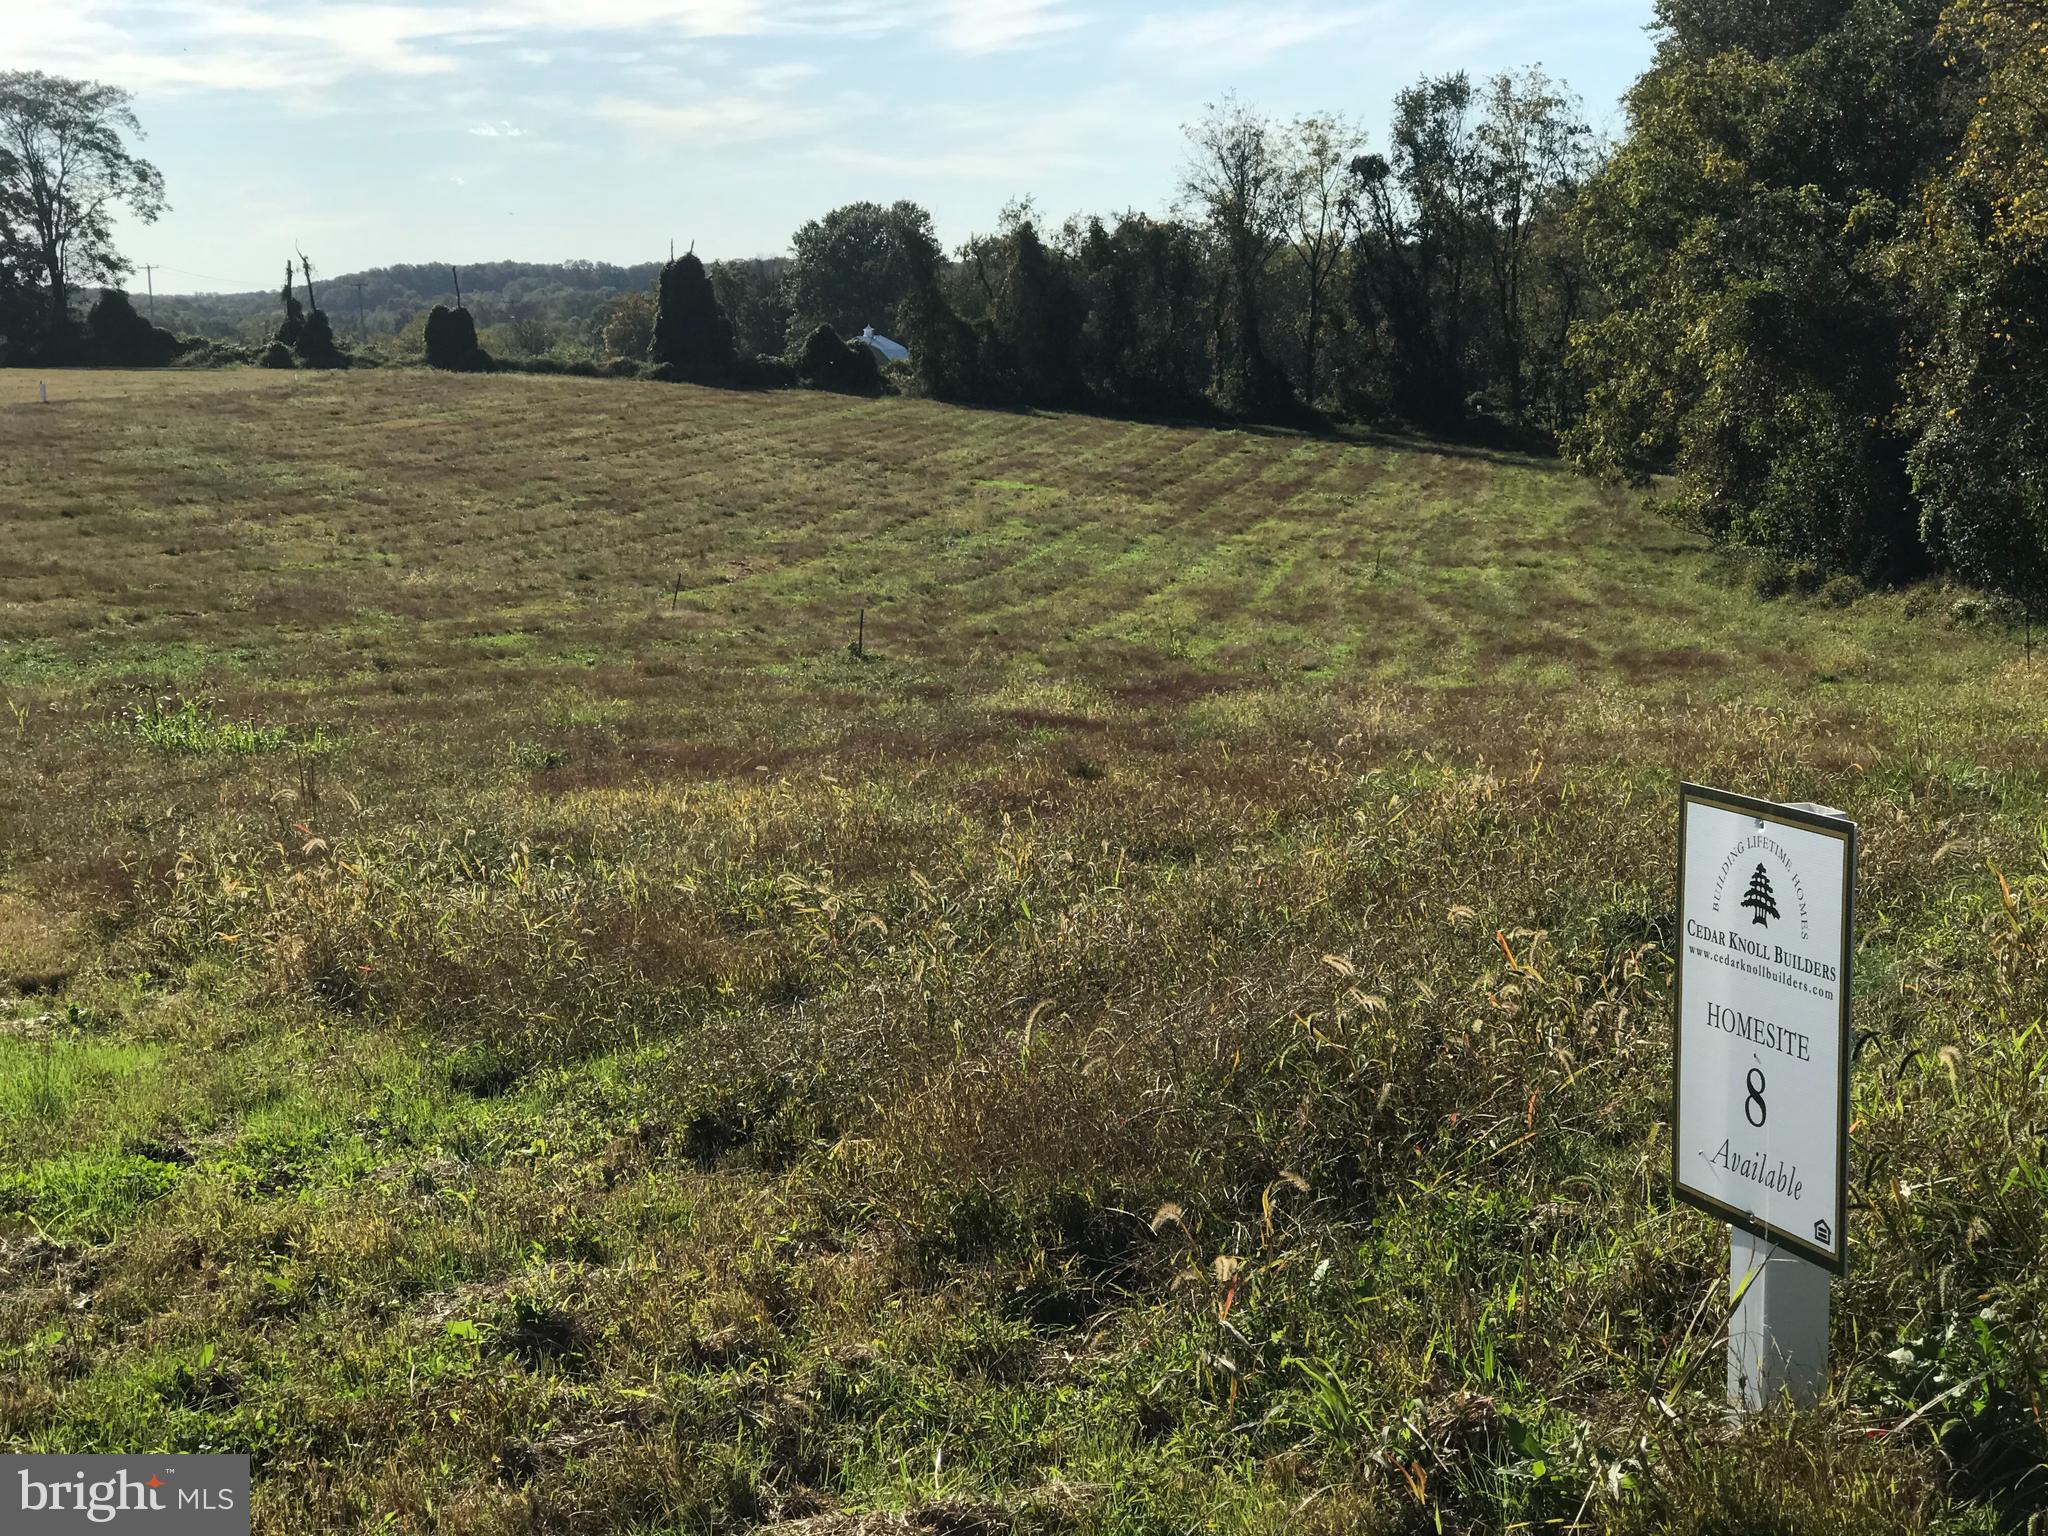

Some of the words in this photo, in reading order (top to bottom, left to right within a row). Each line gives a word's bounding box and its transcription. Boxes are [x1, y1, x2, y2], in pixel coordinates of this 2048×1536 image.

[1713, 841, 1745, 912] BUILDING
[1747, 835, 1793, 872] LIFETIME
[1791, 873, 1809, 940] HOMES
[1687, 919, 1726, 947] CEDAR
[1728, 931, 1770, 961] KNOLL
[1774, 945, 1837, 982] BUILDERS
[1688, 945, 1834, 1000] www.cedarknollbuilders.com
[1706, 1001, 1810, 1062] HOMESITE
[1744, 1067, 1767, 1128] 8
[1710, 1138, 1803, 1200] Available
